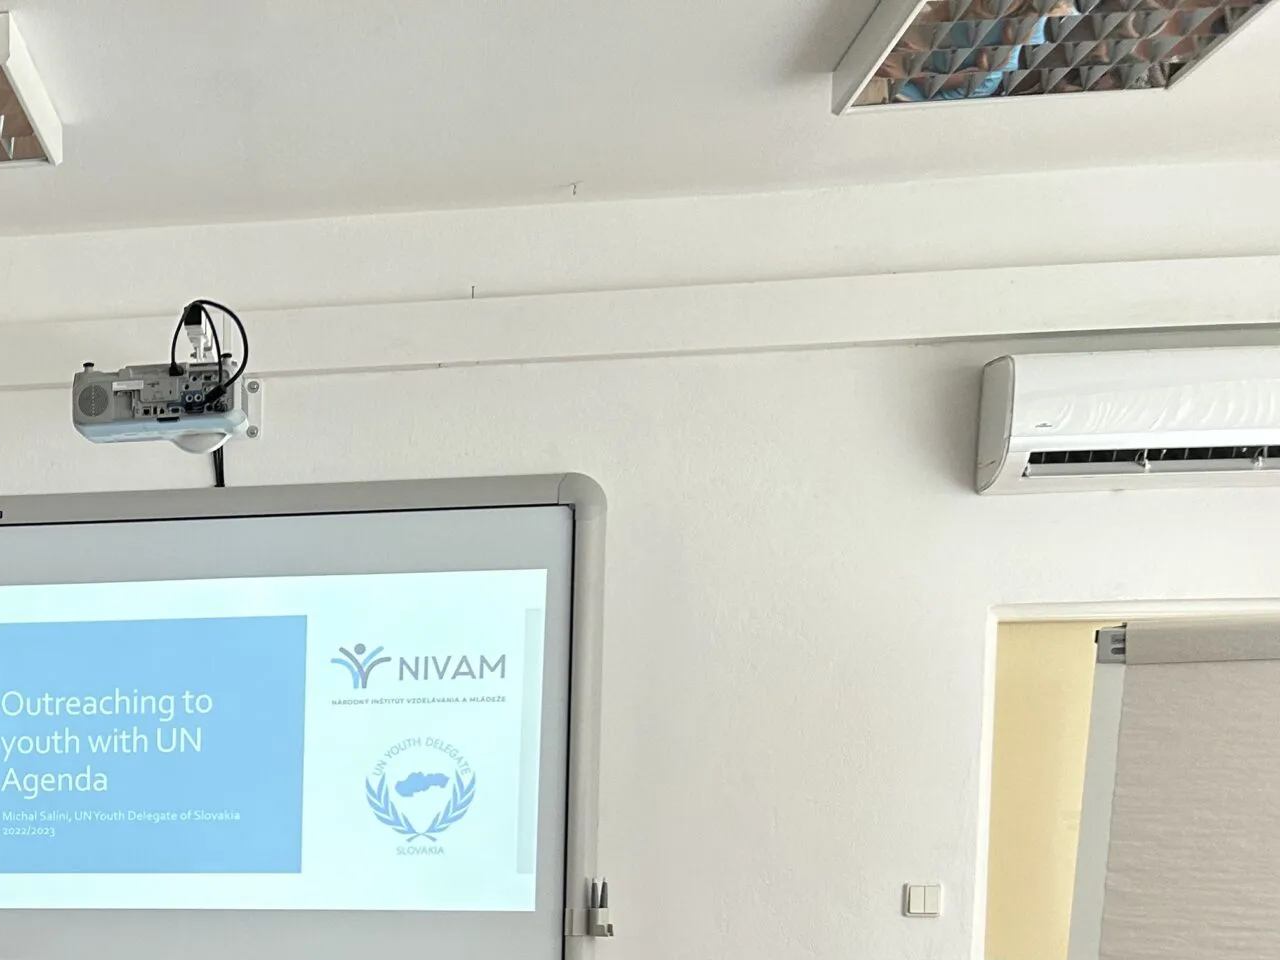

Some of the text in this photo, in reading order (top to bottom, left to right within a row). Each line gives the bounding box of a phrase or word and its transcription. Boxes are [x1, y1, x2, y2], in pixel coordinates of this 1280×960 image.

[398, 654, 506, 681] NIVAM
[1, 688, 213, 722] Outreaching to
[0, 726, 203, 762] youth with UN
[372, 736, 472, 776] UN YOUTH DELEGATE
[0, 765, 108, 800] Agenda
[2, 810, 37, 821] Michal
[74, 811, 91, 821] UN
[93, 811, 125, 821] Youth
[127, 810, 177, 823] Delegate
[179, 810, 193, 821] of
[193, 810, 241, 821] Slovakia
[3, 826, 56, 837] 2022/2023
[395, 846, 444, 856] SLOVAKIA
